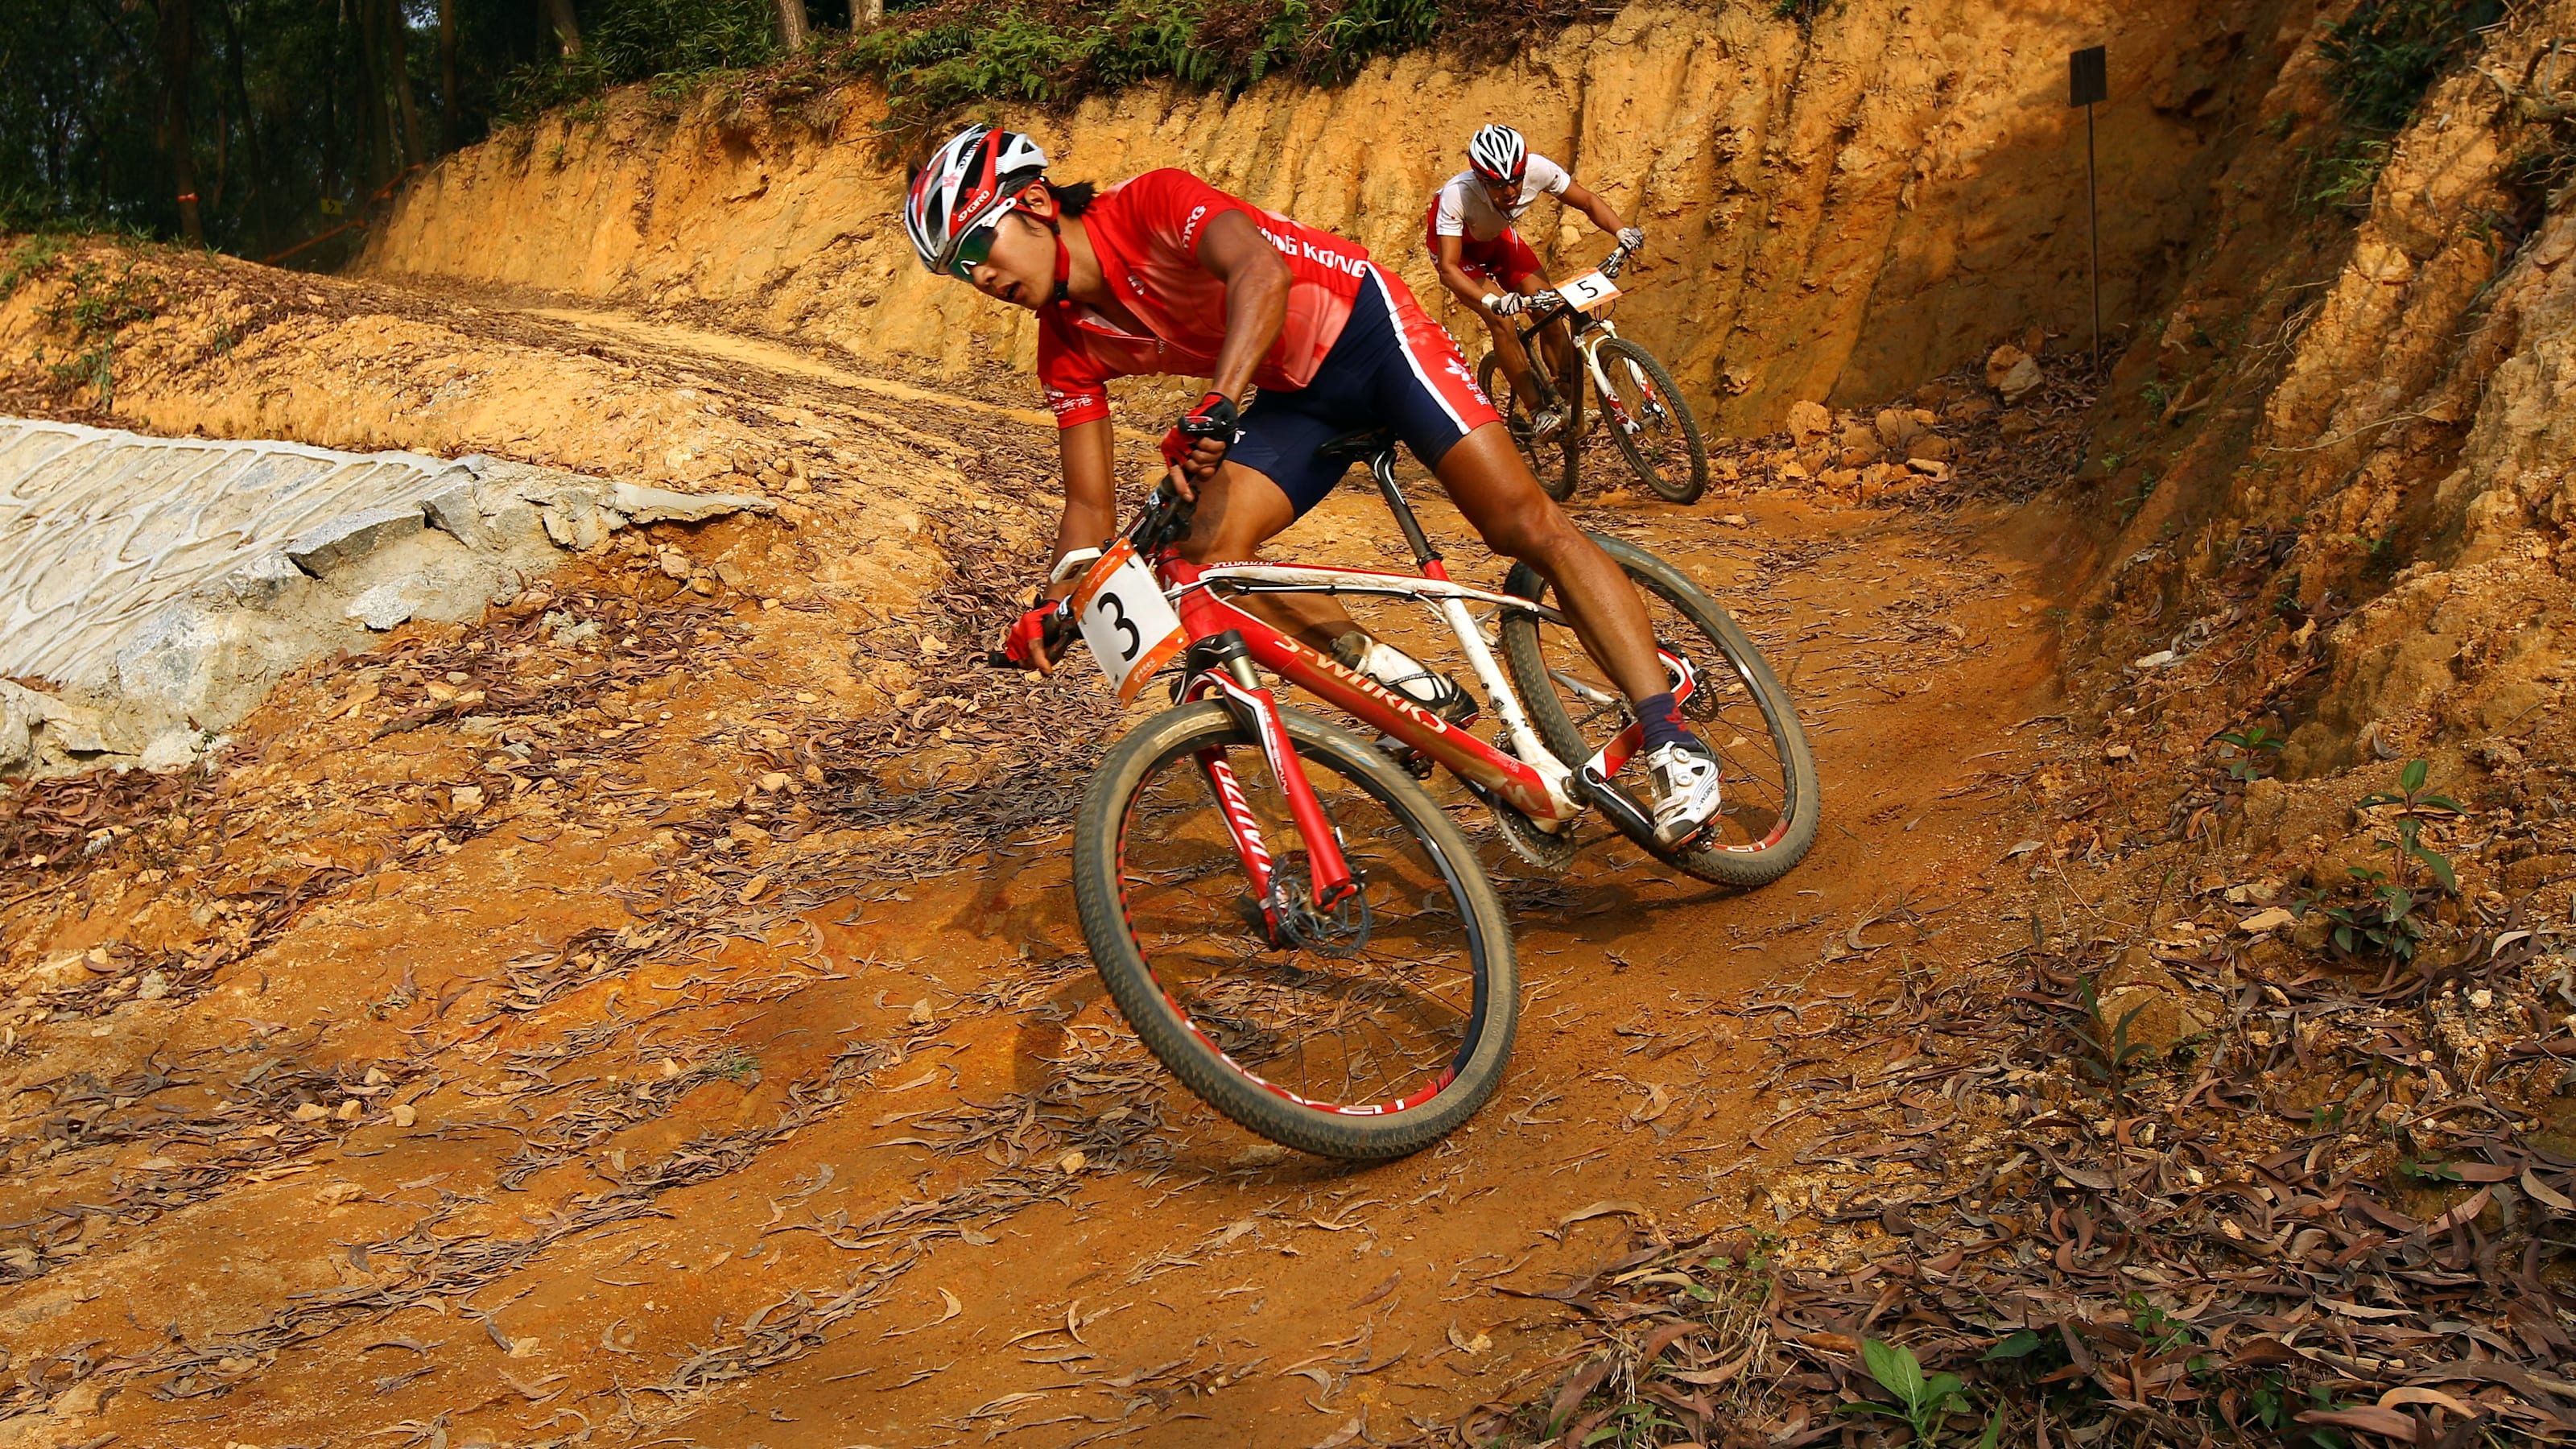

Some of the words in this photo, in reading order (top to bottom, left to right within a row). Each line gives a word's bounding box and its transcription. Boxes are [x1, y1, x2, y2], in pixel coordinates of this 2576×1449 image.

[968, 190, 990, 214] GIRO
[1303, 242, 1369, 279] KONG
[1576, 279, 1599, 299] 5
[1097, 592, 1141, 663] 3
[1274, 634, 1448, 734] S-WORKS
